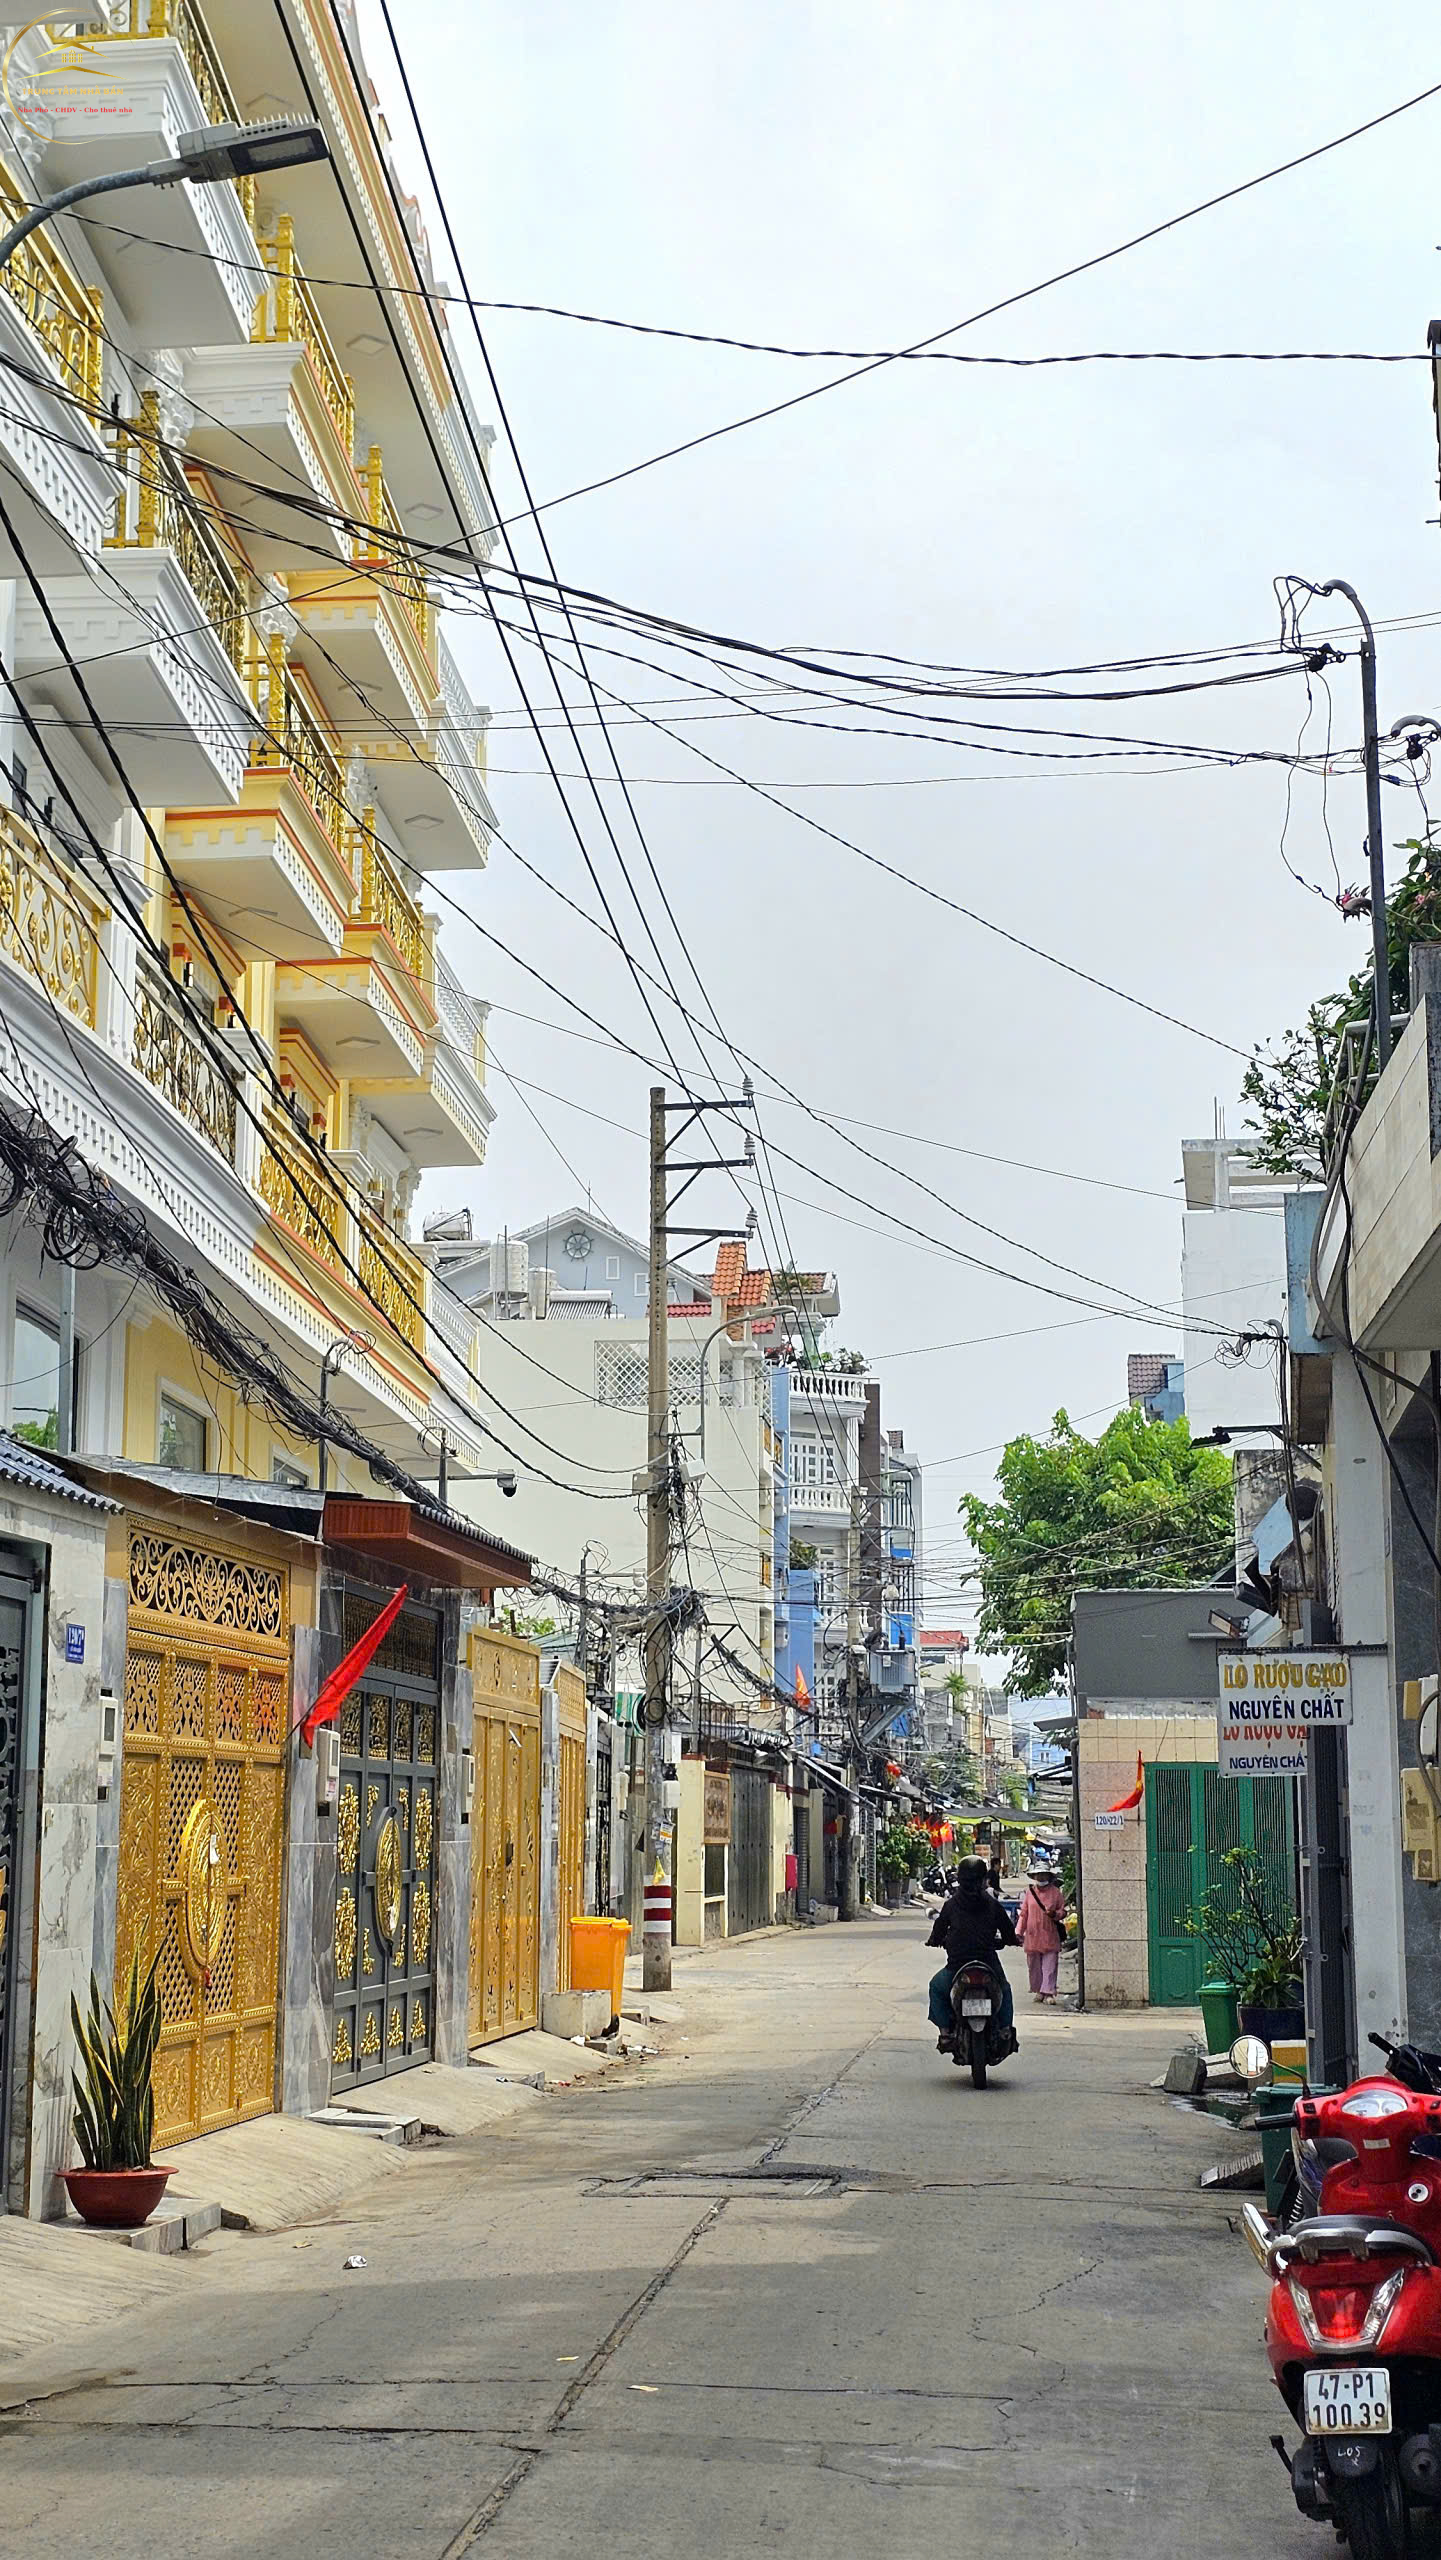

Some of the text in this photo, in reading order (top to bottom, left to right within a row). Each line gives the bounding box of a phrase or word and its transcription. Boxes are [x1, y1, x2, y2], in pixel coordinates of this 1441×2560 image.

[1223, 1656, 1348, 1695] LÒ RƯỢU GẠO
[1229, 1691, 1344, 1720] NGUYÊN CHẤT
[1229, 1754, 1279, 1769] NGUYÊN
